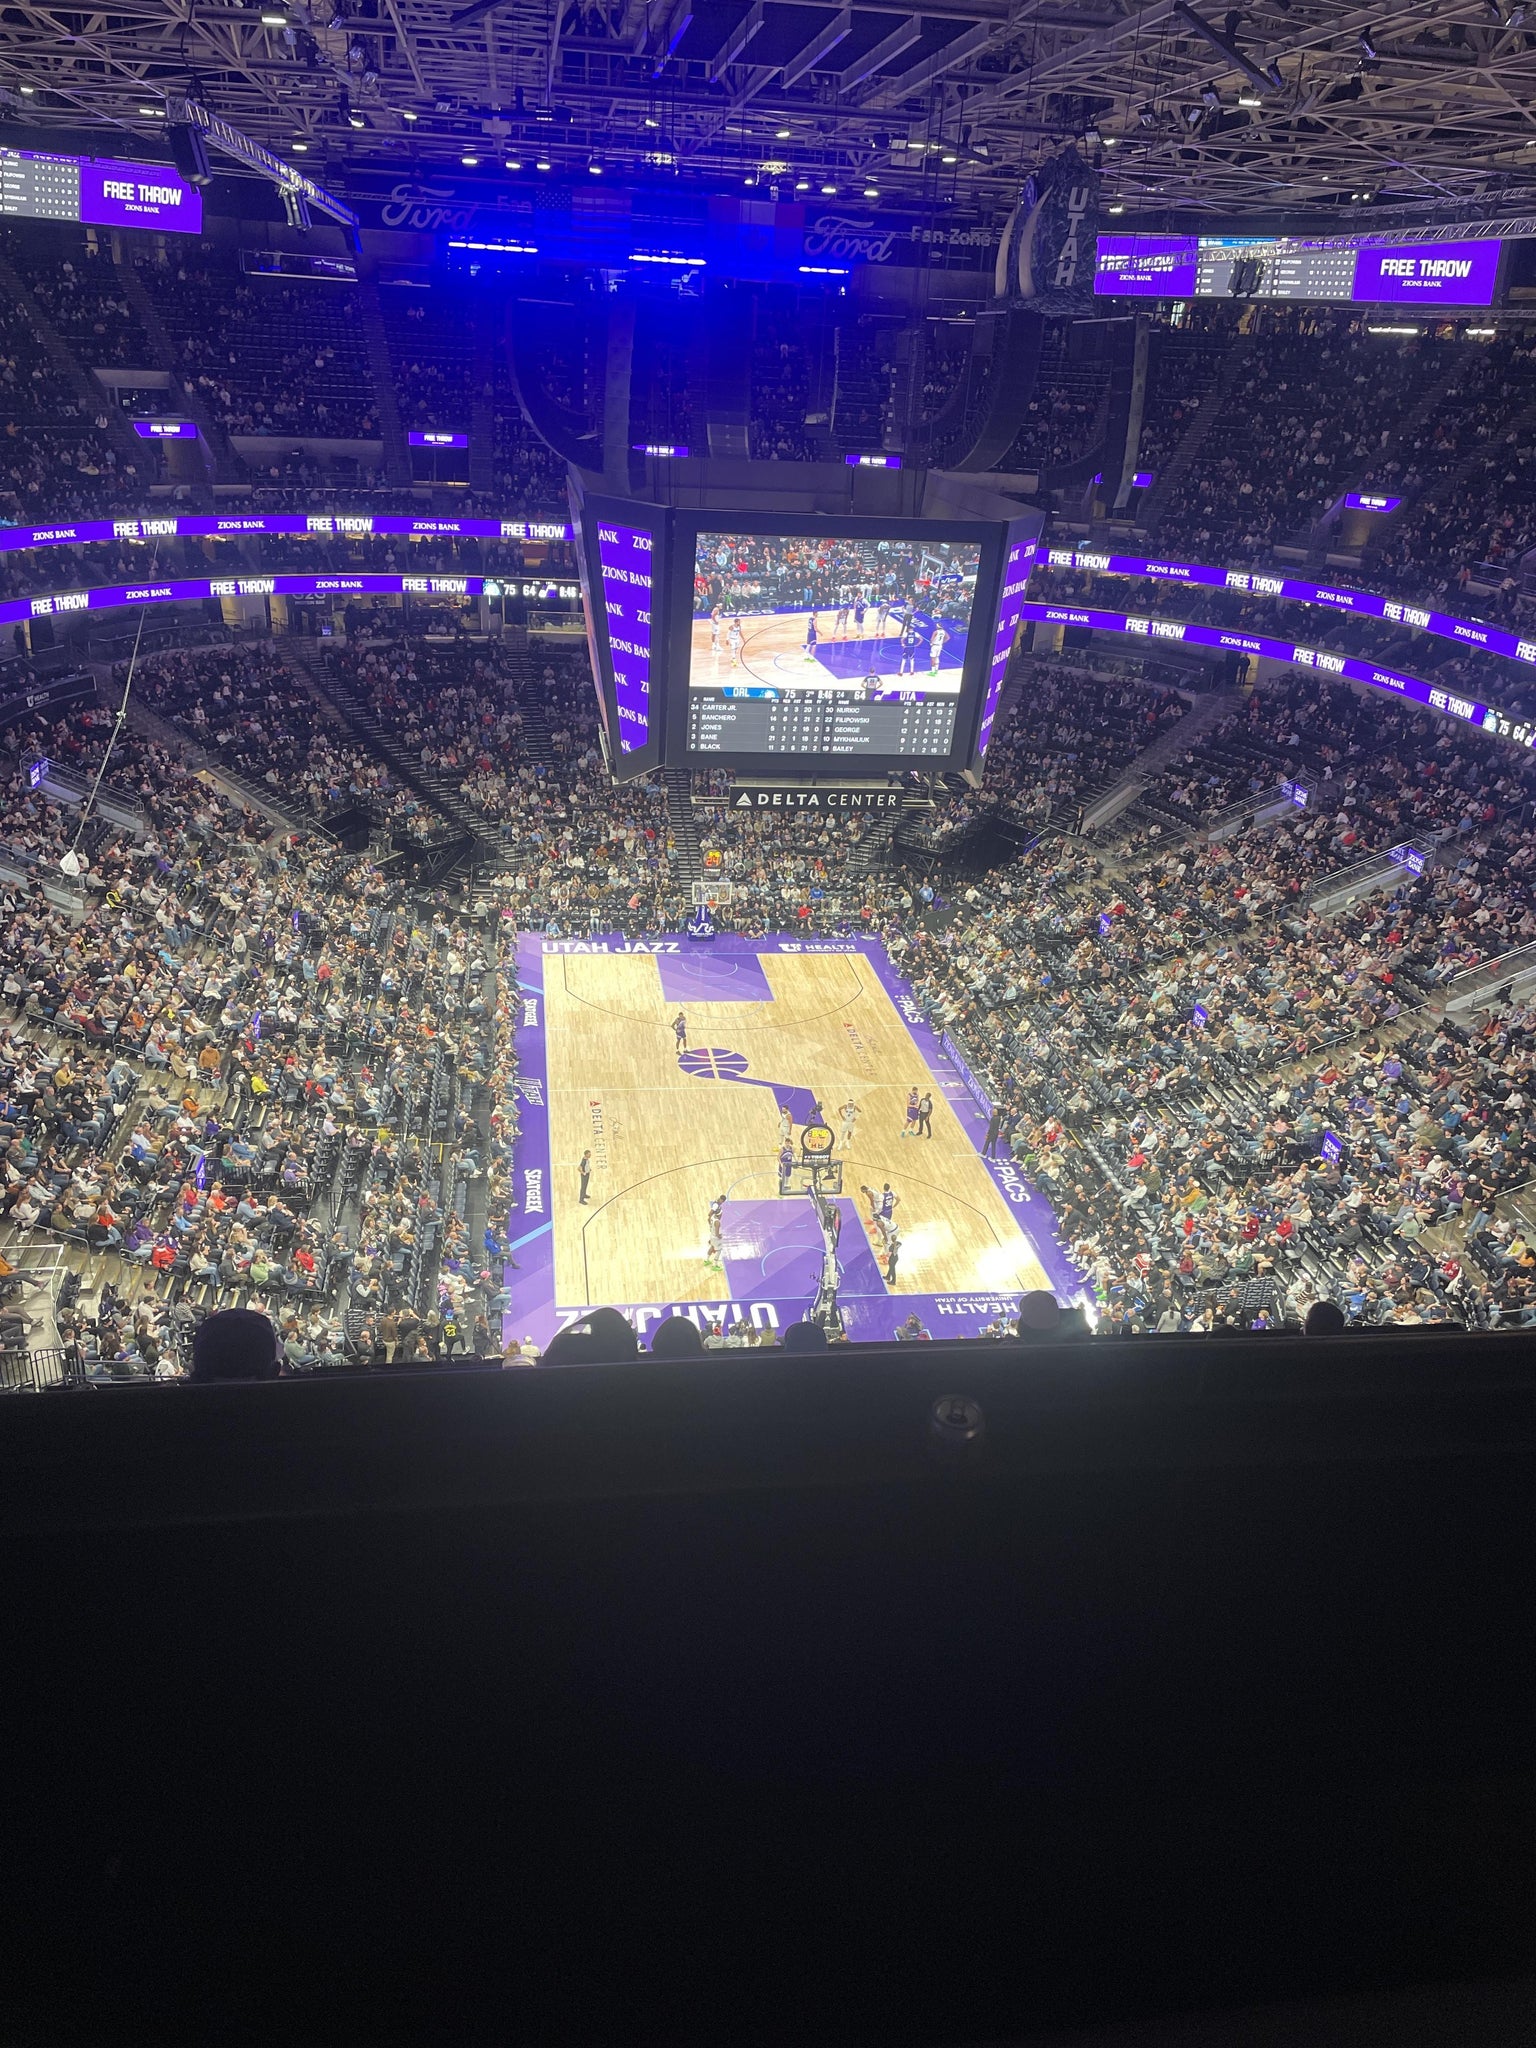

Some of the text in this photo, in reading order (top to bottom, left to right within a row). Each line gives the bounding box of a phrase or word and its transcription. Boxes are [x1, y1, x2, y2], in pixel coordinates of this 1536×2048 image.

[103, 181, 182, 206] FREE THROW
[125, 204, 160, 214] ZIONS BANK
[381, 184, 479, 230] Ford
[804, 216, 896, 262] Ford
[911, 226, 944, 243] Fan
[1054, 186, 1089, 287] UTAH
[1380, 259, 1472, 277] FREE THROW
[113, 520, 177, 537] FREE THROW
[306, 518, 373, 532] FREE THROW
[438, 523, 461, 531] BANK
[500, 524, 565, 538] FREE THROW
[33, 529, 77, 541] ZIONS BANK
[1048, 551, 1110, 569] FREE THROW
[602, 565, 628, 582] ZIONS
[1146, 564, 1190, 577] ZIONS BANK
[210, 579, 275, 595] FREE THROW
[402, 578, 467, 592] FREE THROW
[503, 584, 516, 595] 75
[523, 585, 536, 596] 64
[1225, 572, 1284, 594] FREE THROW
[126, 588, 172, 599] ZIONS BANK
[1316, 591, 1354, 606] ZIONS BANK
[30, 594, 89, 615] FREE THROW
[1046, 611, 1090, 622] ZIONS BANK
[1382, 602, 1431, 628] FREE THROW
[1125, 618, 1186, 639] FREE THROW
[1454, 626, 1488, 643] ZIONS BANK
[1220, 636, 1261, 650] ZIONS BANK
[1515, 641, 1536, 662] FREE
[1292, 649, 1345, 673] FREE THROW
[1372, 672, 1405, 690] ZIONS BANK
[733, 687, 750, 697] ORL
[785, 689, 796, 699] 75
[854, 691, 866, 700] 64
[900, 691, 916, 701] UTA
[1428, 689, 1448, 709] FREE
[1448, 696, 1475, 719] THROW
[1498, 719, 1510, 735] 75
[1513, 726, 1526, 741] 64
[758, 793, 896, 806] DELTA CENTER
[541, 942, 680, 953] UTAH JAZZ
[523, 998, 538, 1027] SEATGEEK
[900, 995, 924, 1024] PACS
[592, 1108, 607, 1170] DELTA CENTER
[524, 1169, 544, 1214] SEATGEEK
[994, 1164, 1030, 1203] PACS
[937, 1302, 1019, 1315] HEALTH
